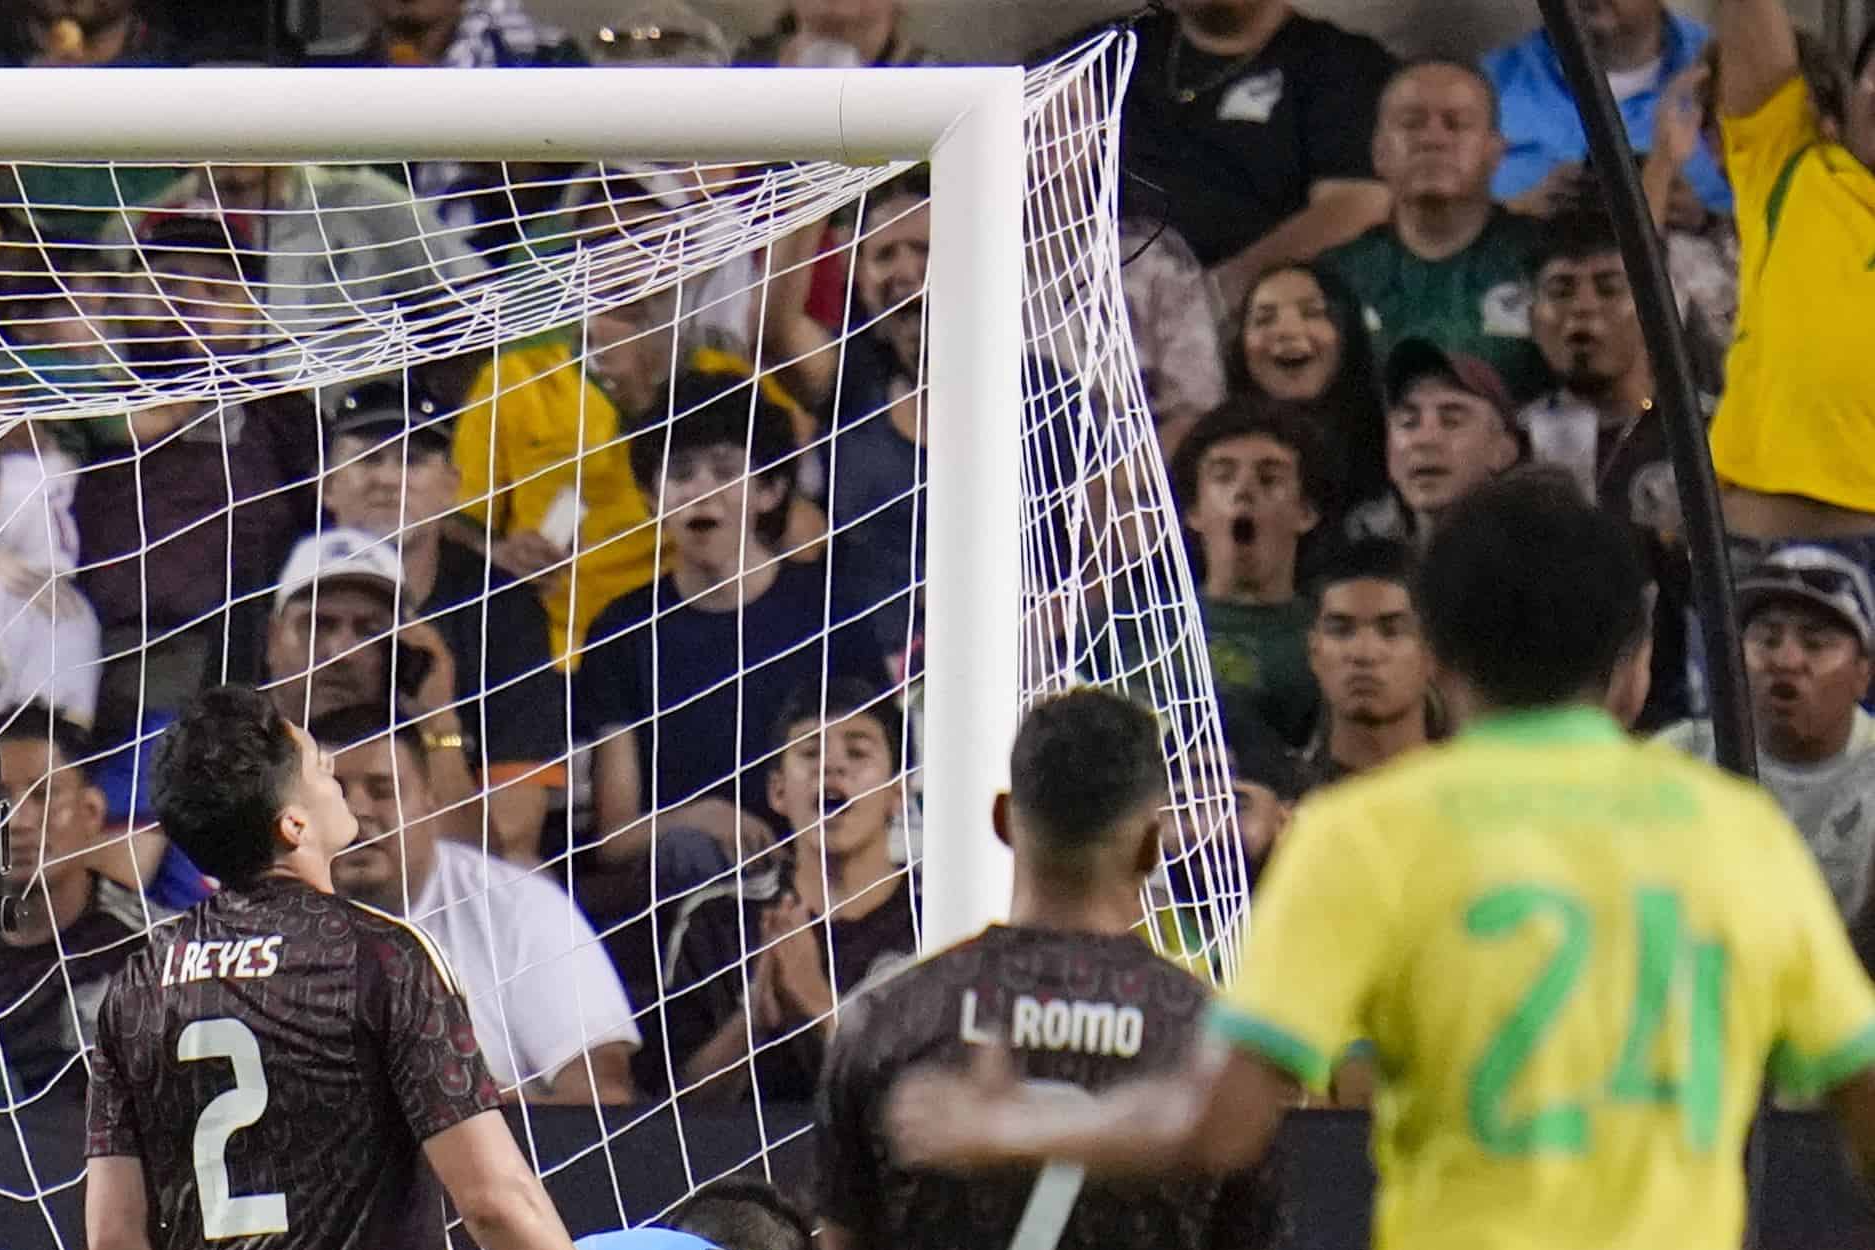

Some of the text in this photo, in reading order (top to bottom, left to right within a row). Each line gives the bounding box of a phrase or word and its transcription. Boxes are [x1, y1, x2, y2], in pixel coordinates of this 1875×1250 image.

[177, 1016, 289, 1241] 2
[1014, 995, 1144, 1058] ROMO
[1460, 884, 1732, 1154] 24
